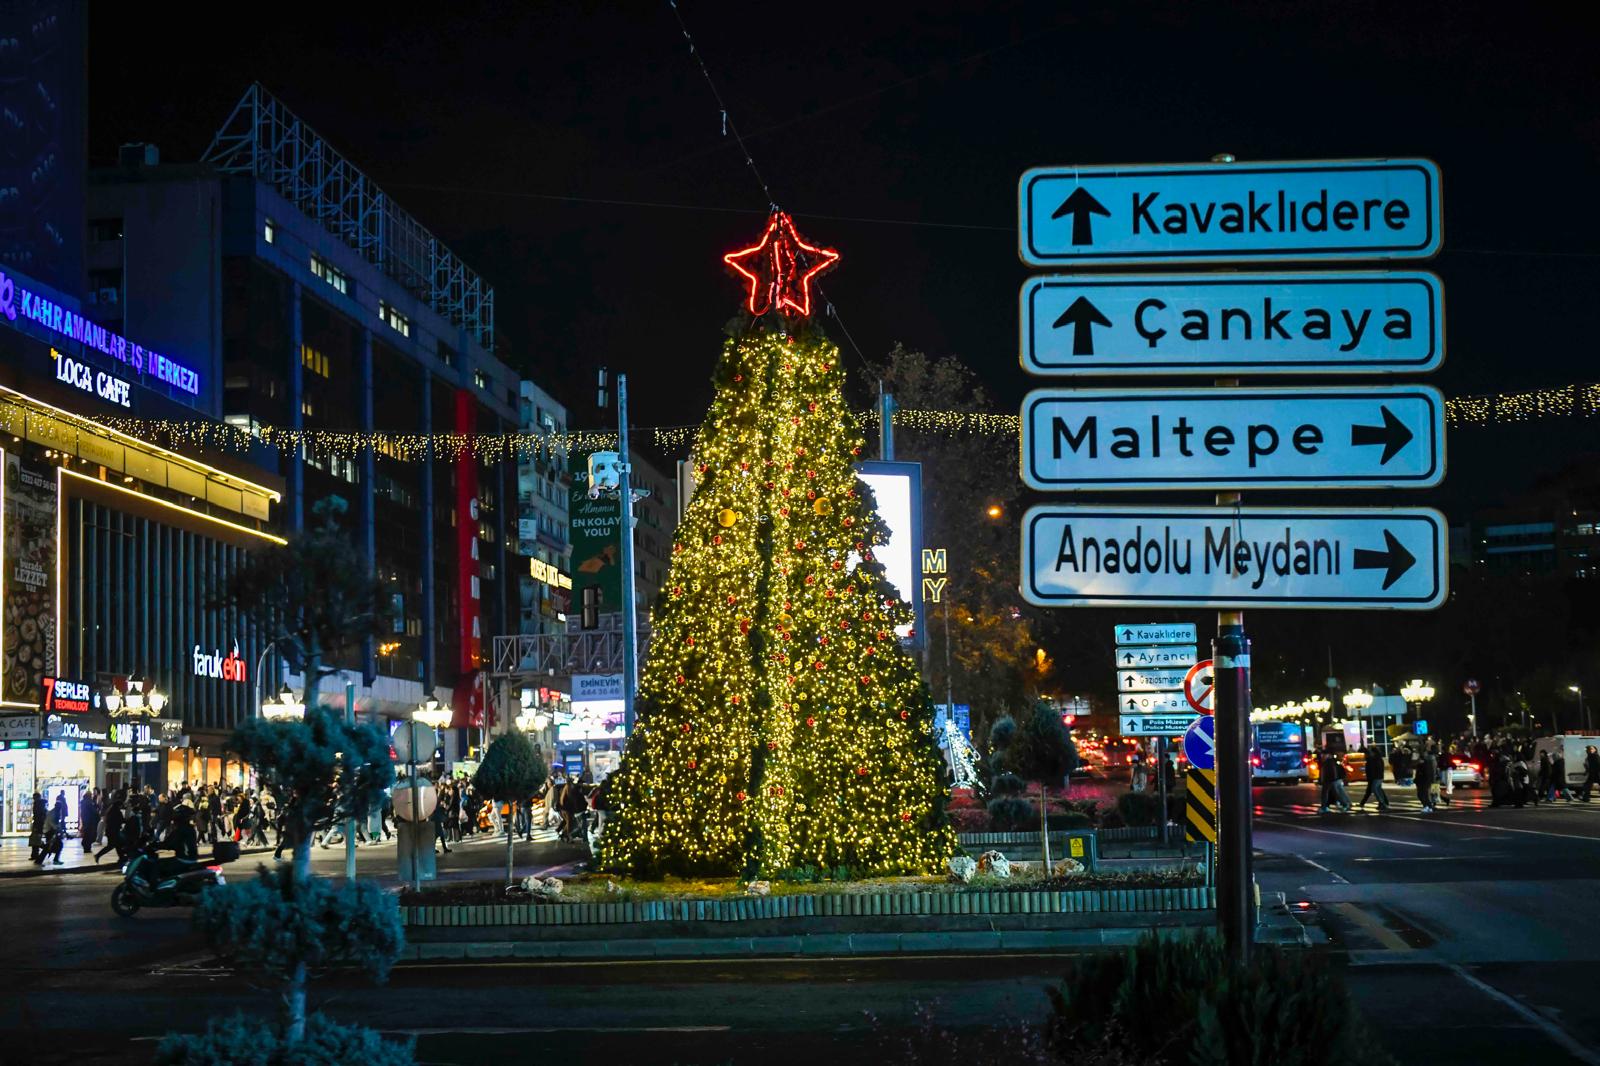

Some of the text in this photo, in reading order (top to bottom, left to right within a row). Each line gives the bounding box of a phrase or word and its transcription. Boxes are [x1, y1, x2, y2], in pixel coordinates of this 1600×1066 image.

[1132, 189, 1411, 235] Kavaklıdere
[21, 289, 127, 362] KAHRAMANLAR
[1134, 297, 1412, 352] Çankaya
[56, 354, 131, 407] LOCA CAFE
[1052, 415, 1324, 468] Maltepe
[574, 471, 588, 483] 19
[572, 516, 621, 528] EN KOLAY
[583, 527, 611, 537] YOLU
[1055, 524, 1341, 590] Anadolu Meydanı
[14, 567, 48, 588] LEZZET
[1137, 629, 1192, 640] Kavaklıdere
[1139, 652, 1191, 664] Ayrancı
[43, 678, 90, 711] 7 SERLER
[55, 699, 90, 712] TECHNOLOGY
[61, 723, 80, 738] OCA
